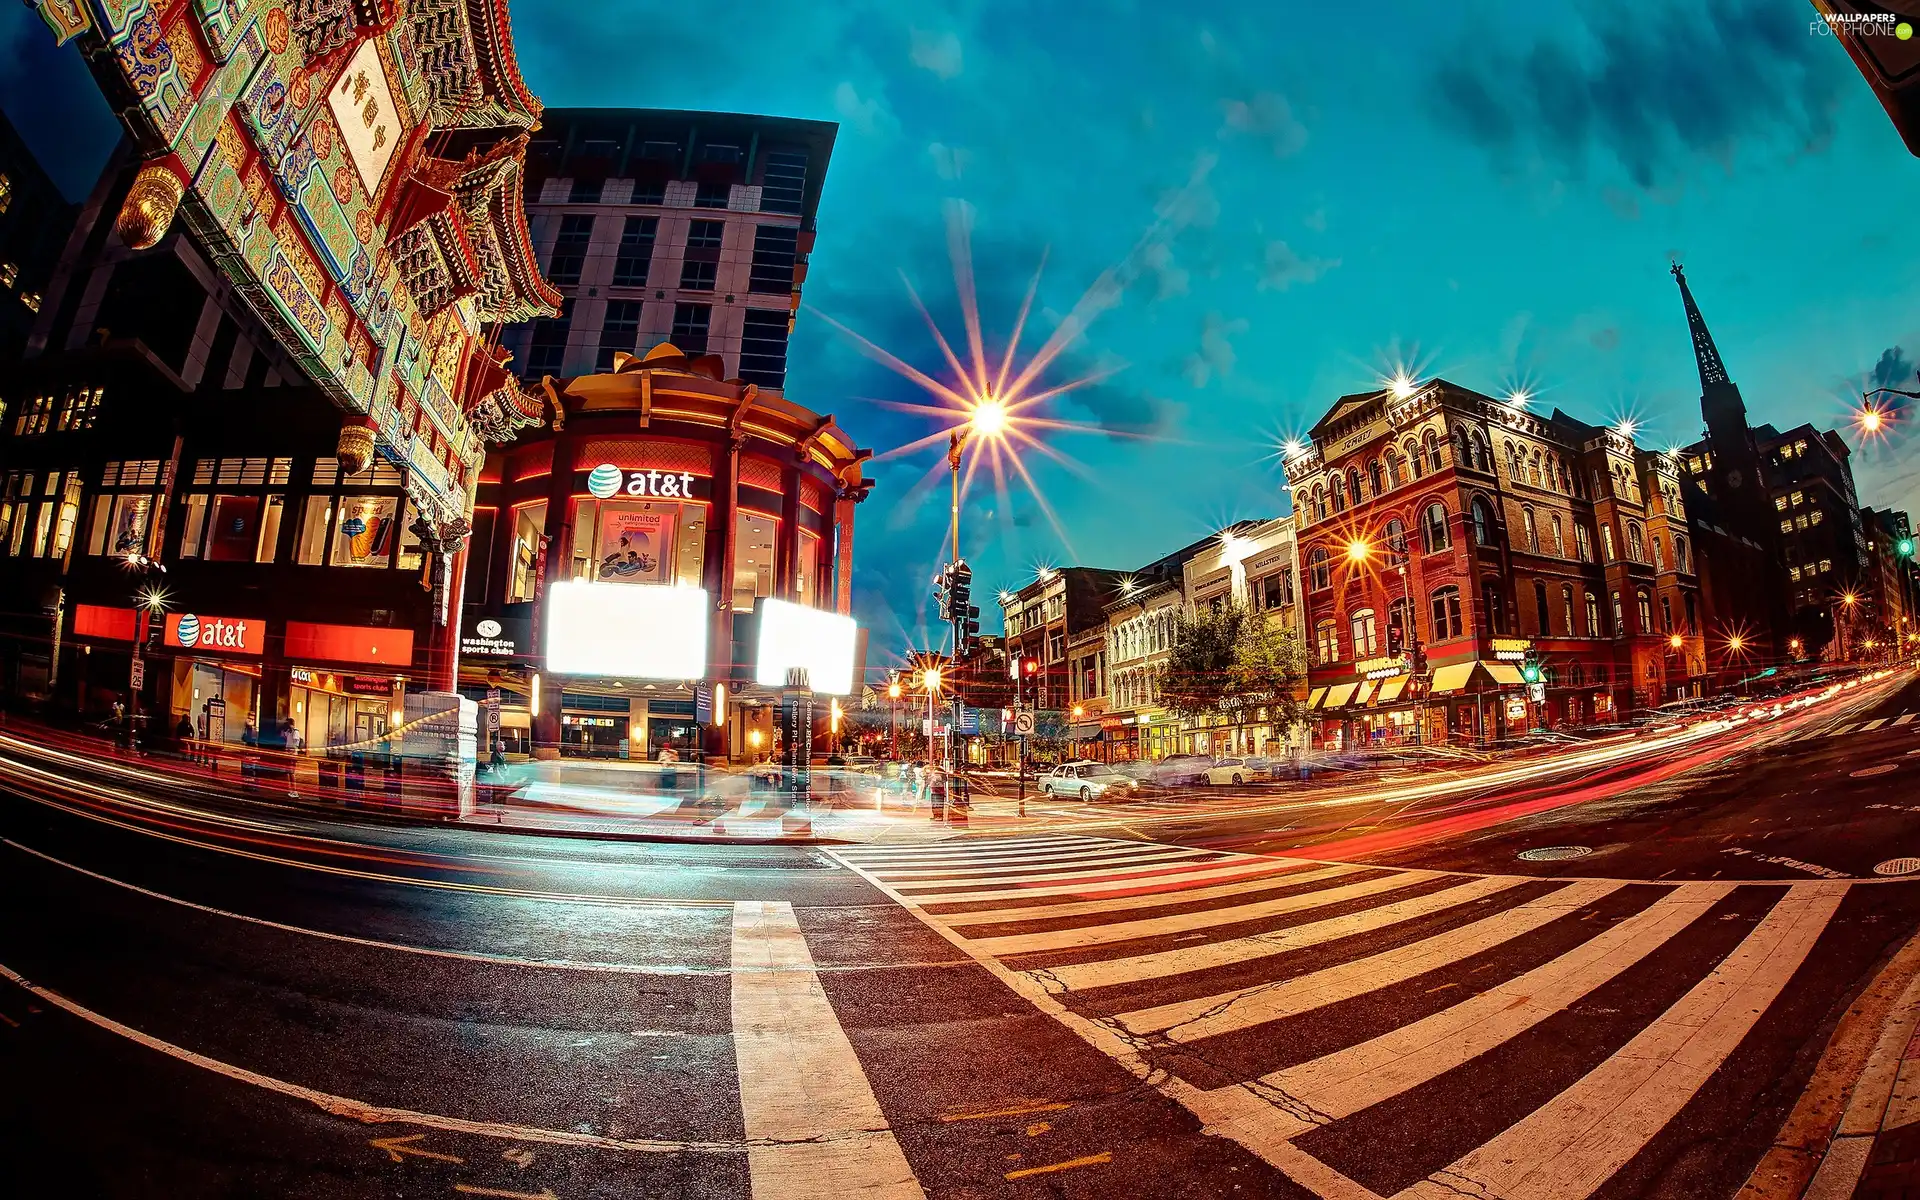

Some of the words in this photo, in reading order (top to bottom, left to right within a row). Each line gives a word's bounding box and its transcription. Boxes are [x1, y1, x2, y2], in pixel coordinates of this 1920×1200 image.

[627, 469, 695, 498] at&t
[618, 514, 660, 523] unlimited
[201, 618, 247, 649] at&t
[462, 638, 515, 648] washington
[461, 645, 489, 653] sports
[490, 646, 515, 655] clubs
[132, 675, 142, 687] 25
[353, 683, 372, 691] sports
[372, 684, 389, 692] clubs
[570, 717, 615, 727] ZENGO
[791, 700, 799, 729] Gallery
[805, 700, 813, 729] Gallery
[791, 785, 799, 813] Station
[805, 785, 813, 813] Station
